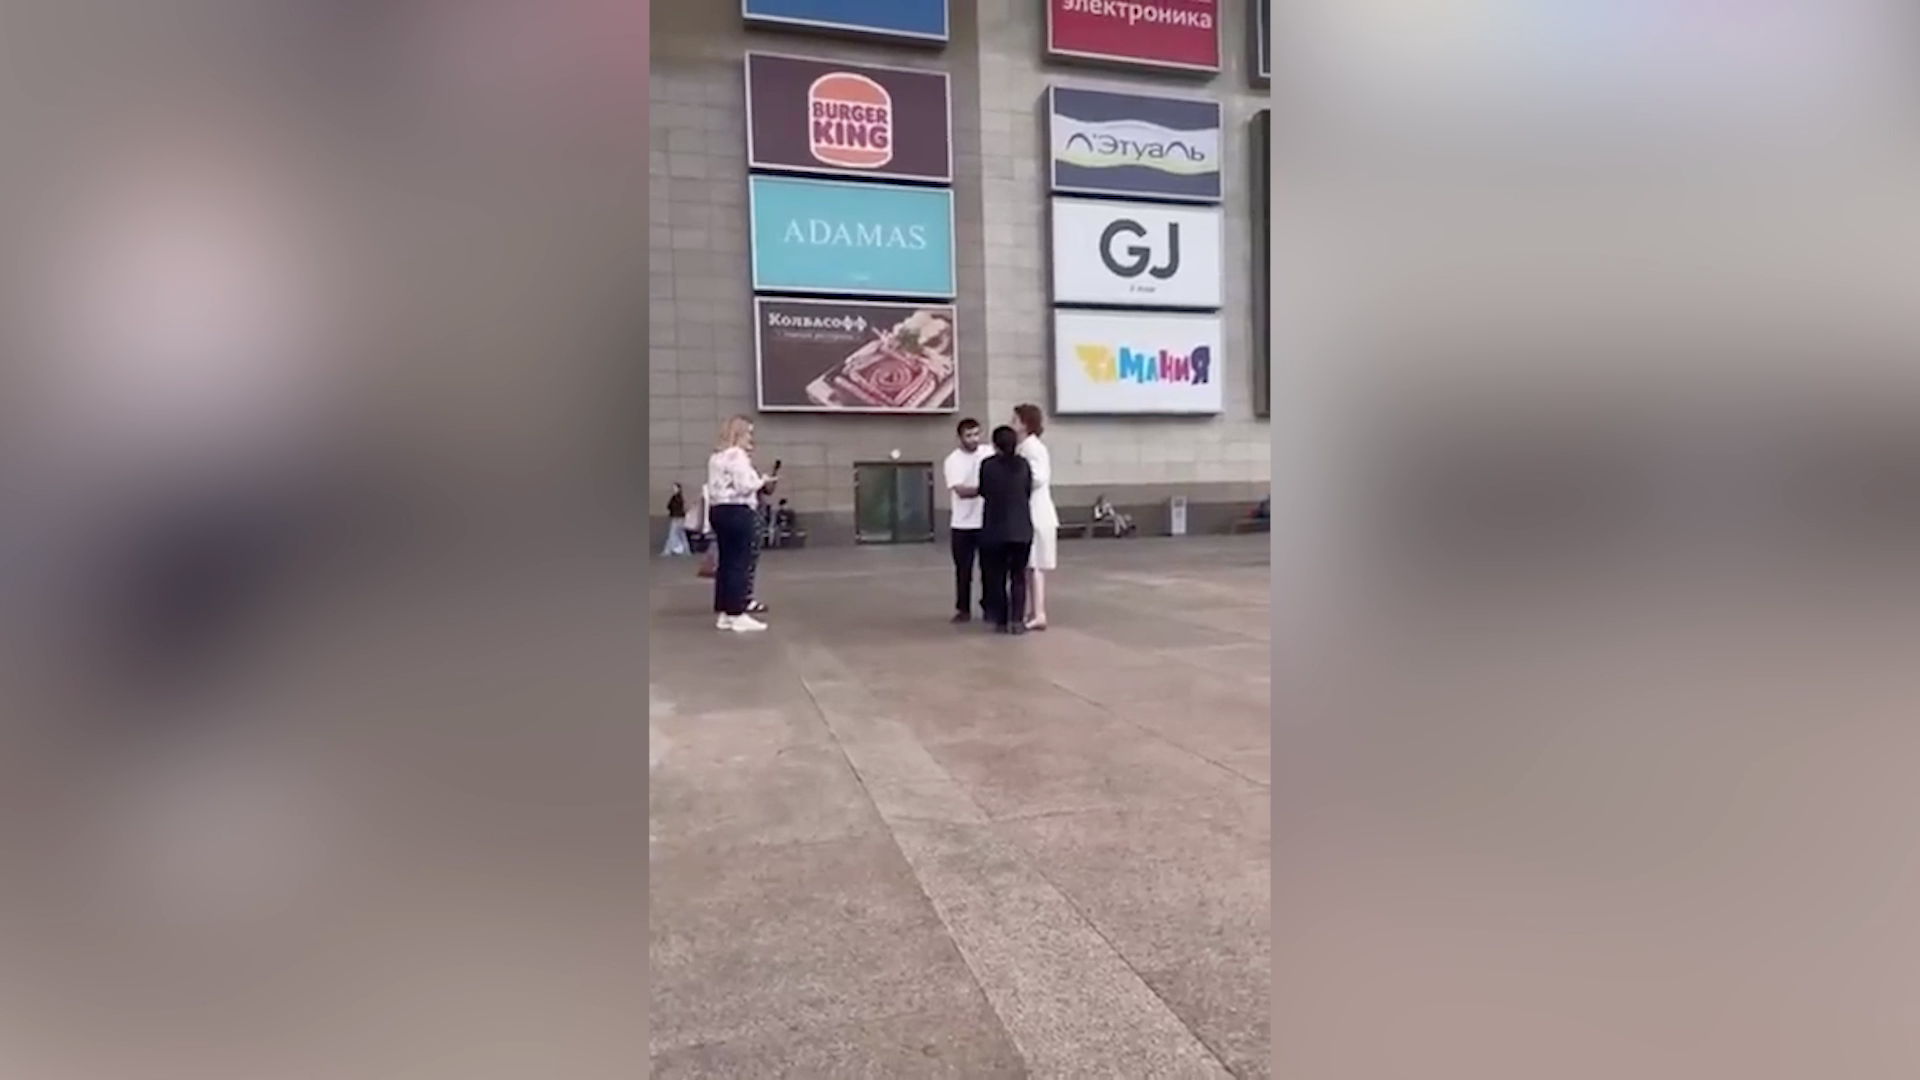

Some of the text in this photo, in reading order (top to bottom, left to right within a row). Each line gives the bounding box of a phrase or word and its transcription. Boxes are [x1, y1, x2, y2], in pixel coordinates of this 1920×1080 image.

[1062, 0, 1212, 29] электроника
[813, 101, 888, 124] BURGER
[813, 120, 888, 149] KING
[783, 218, 927, 250] ADAMAS
[1099, 218, 1180, 279] GJ
